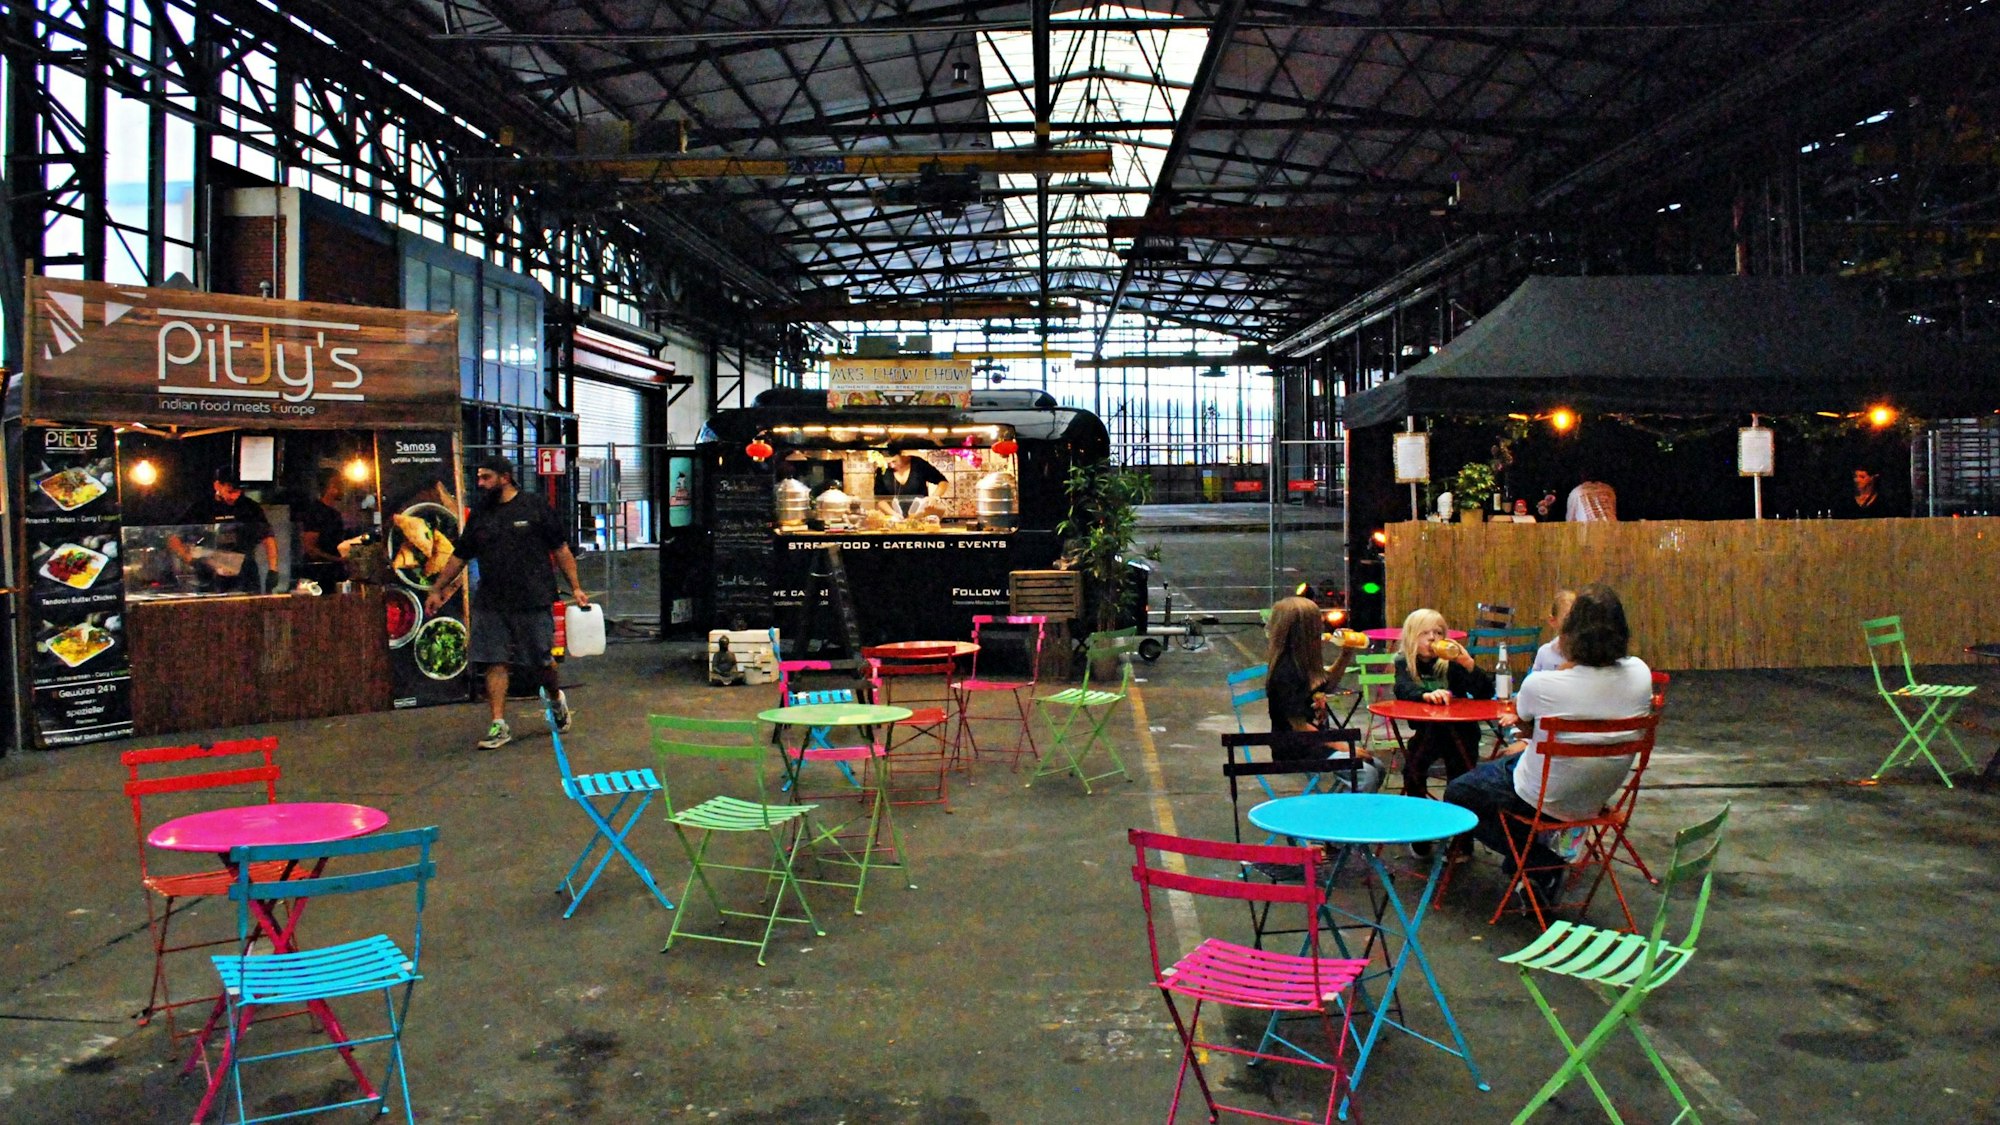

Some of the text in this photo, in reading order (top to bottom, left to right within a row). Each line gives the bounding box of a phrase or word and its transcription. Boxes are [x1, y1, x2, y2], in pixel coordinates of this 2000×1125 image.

[831, 366, 970, 382] MRS CHOW CHOW
[200, 399, 230, 412] food
[233, 401, 271, 414] meets
[272, 402, 316, 417] Europe
[395, 441, 437, 452] Samosa
[882, 541, 946, 550] CATERING
[957, 540, 1007, 549] EVENTS
[58, 687, 96, 699] Gewürze
[97, 684, 109, 694] 24
[66, 705, 105, 718] spezieller
